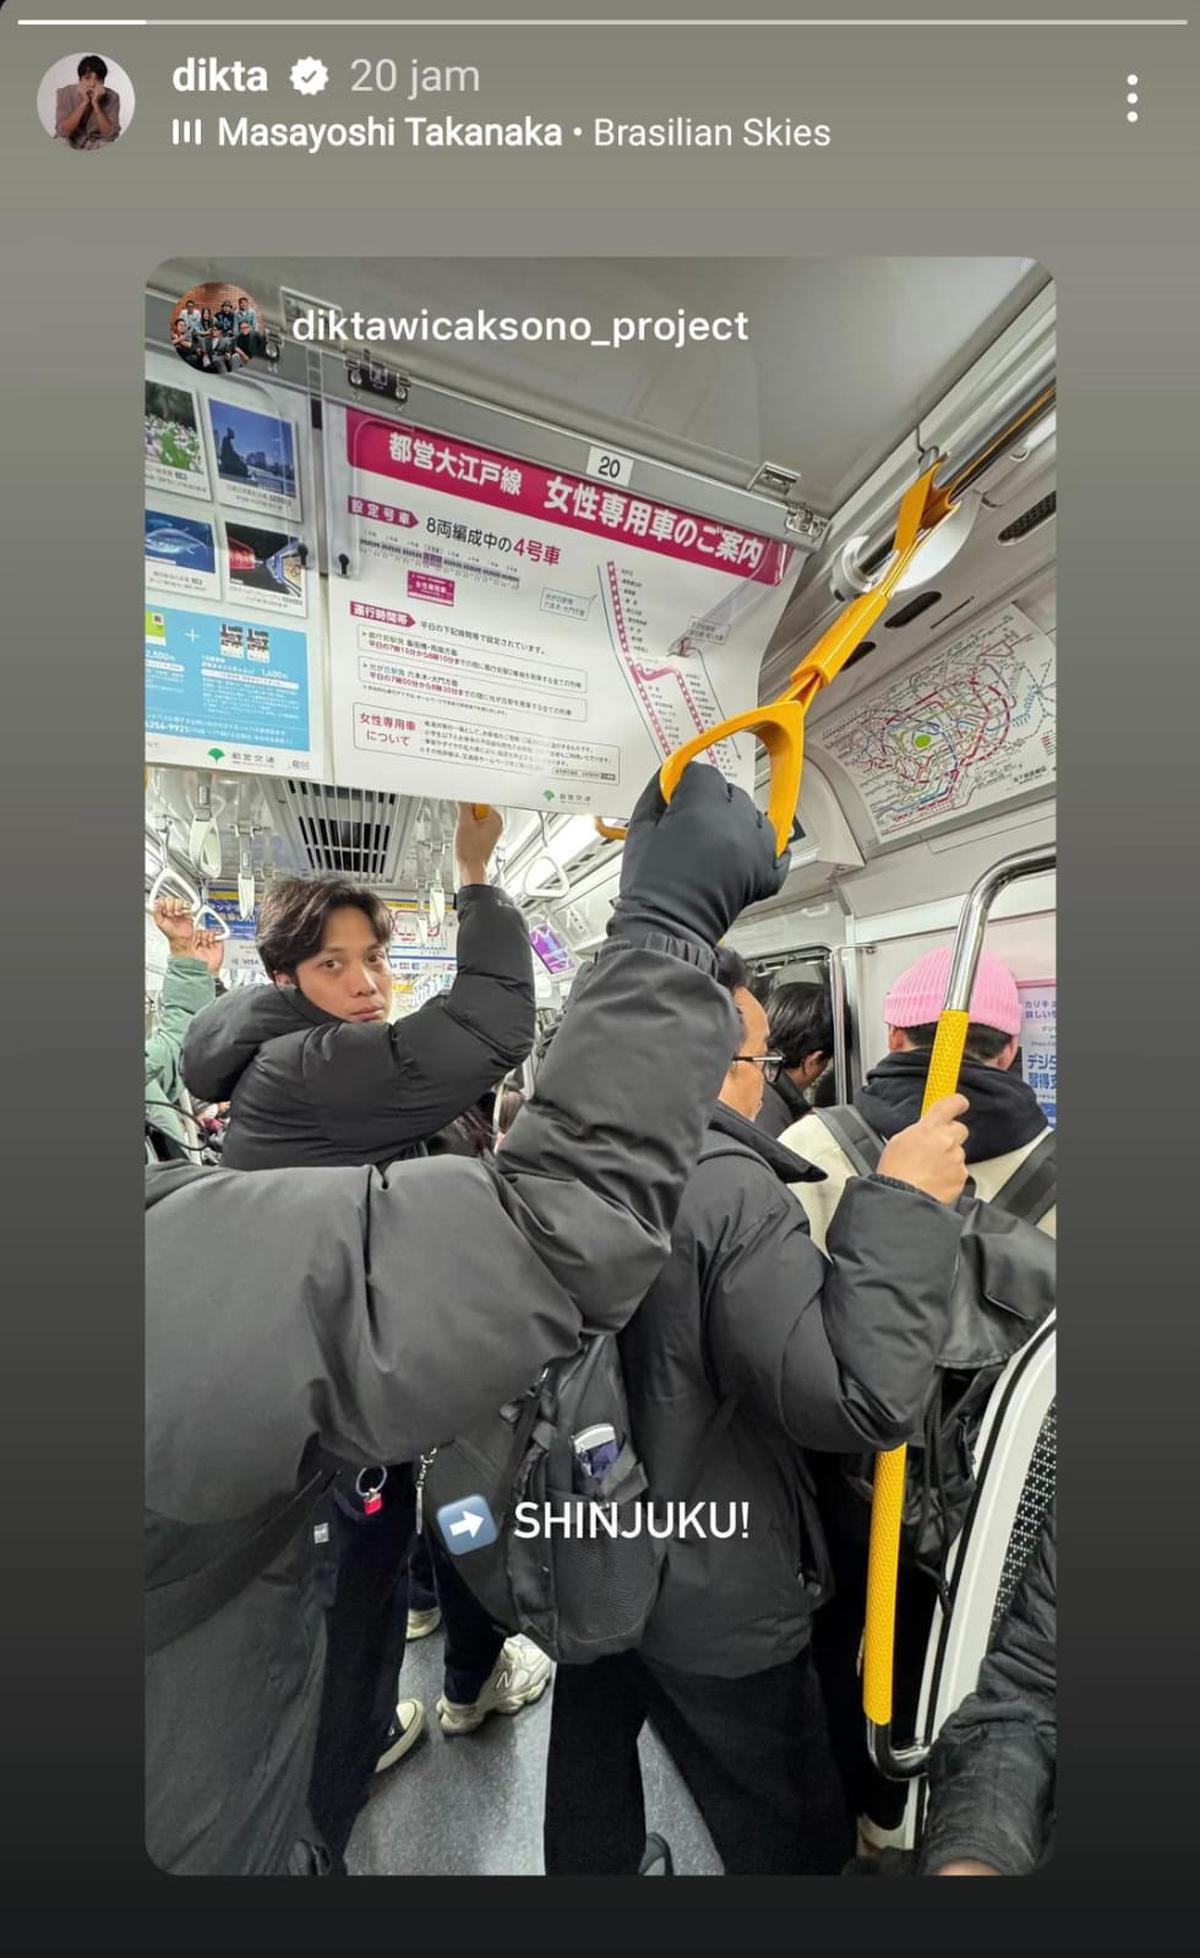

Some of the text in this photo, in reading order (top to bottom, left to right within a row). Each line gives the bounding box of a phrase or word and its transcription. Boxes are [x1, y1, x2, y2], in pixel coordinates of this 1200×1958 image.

[598, 455, 621, 479] 20
[352, 498, 411, 526] 設定号車
[389, 432, 523, 496] 都営大江戸線
[543, 476, 764, 569] 女性専用車のご案内
[426, 516, 562, 566] 8両編成中の4号車
[360, 712, 417, 731] 女性専用車
[366, 730, 411, 747] について
